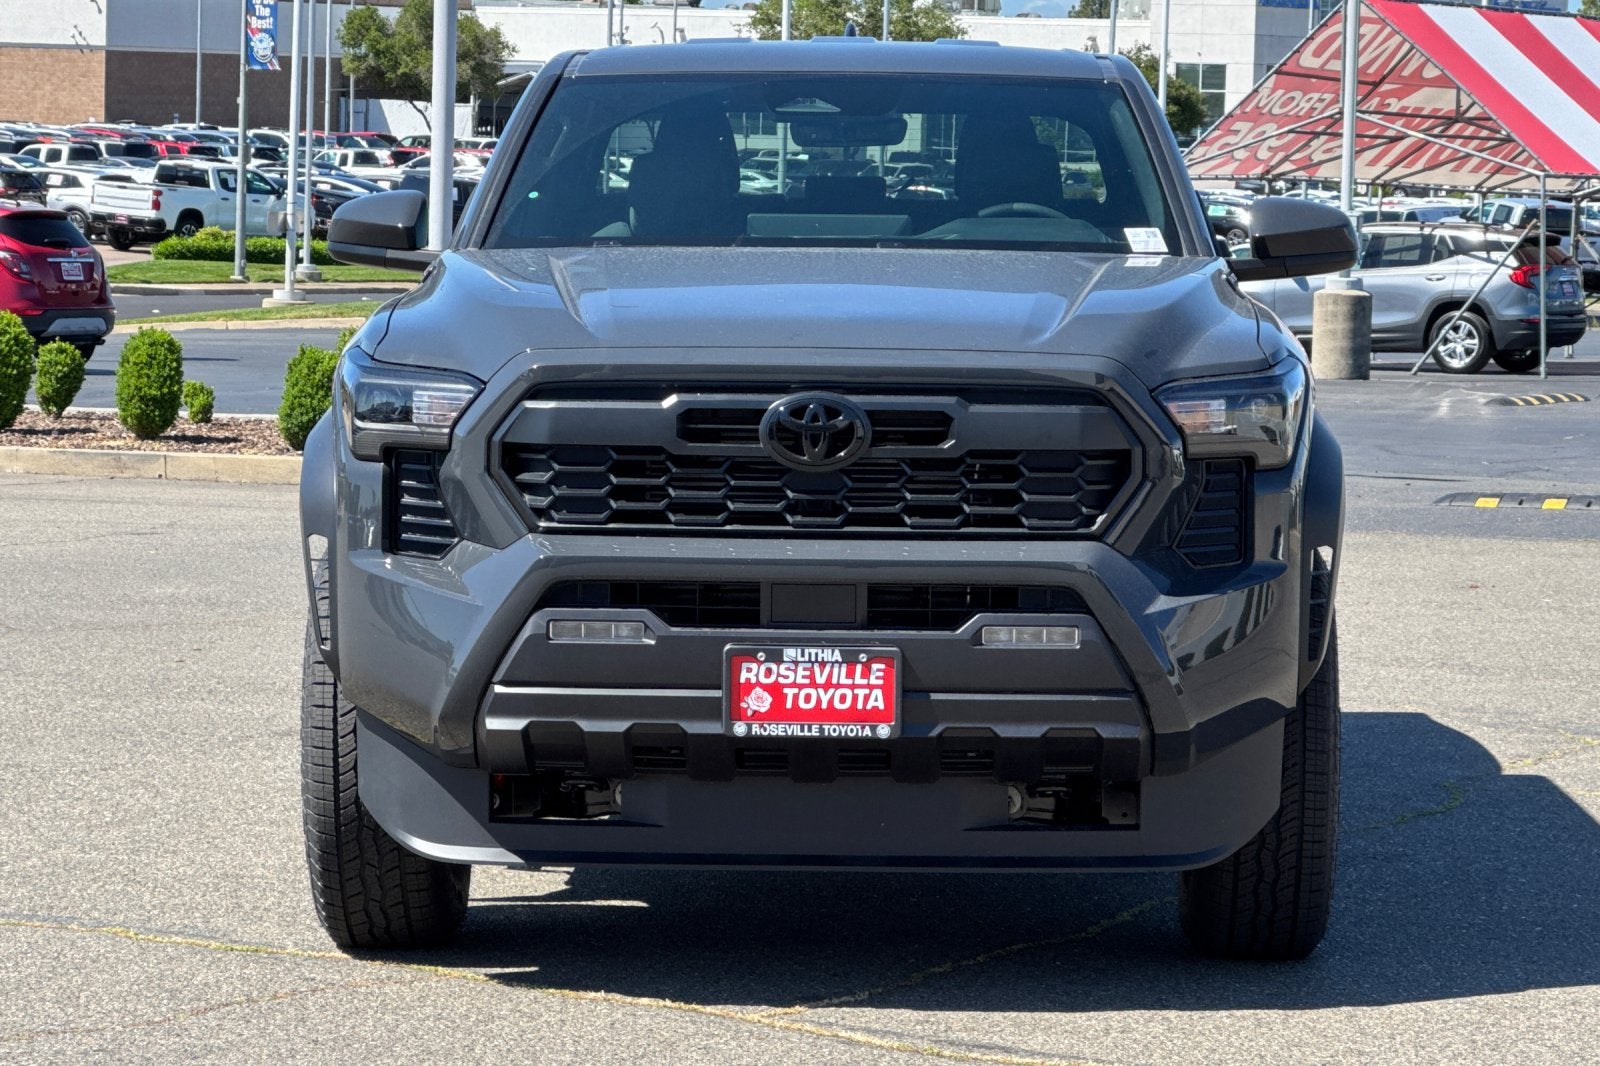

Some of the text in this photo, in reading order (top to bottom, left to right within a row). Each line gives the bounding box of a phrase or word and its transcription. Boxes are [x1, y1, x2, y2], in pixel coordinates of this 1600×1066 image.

[254, 4, 271, 16] The
[251, 16, 273, 29] Best!
[797, 648, 843, 662] LITHIA
[739, 662, 886, 685] ROSEVILLE
[782, 687, 885, 710] TOYOTA
[751, 724, 872, 737] ROSEVILLE TOYOTA
